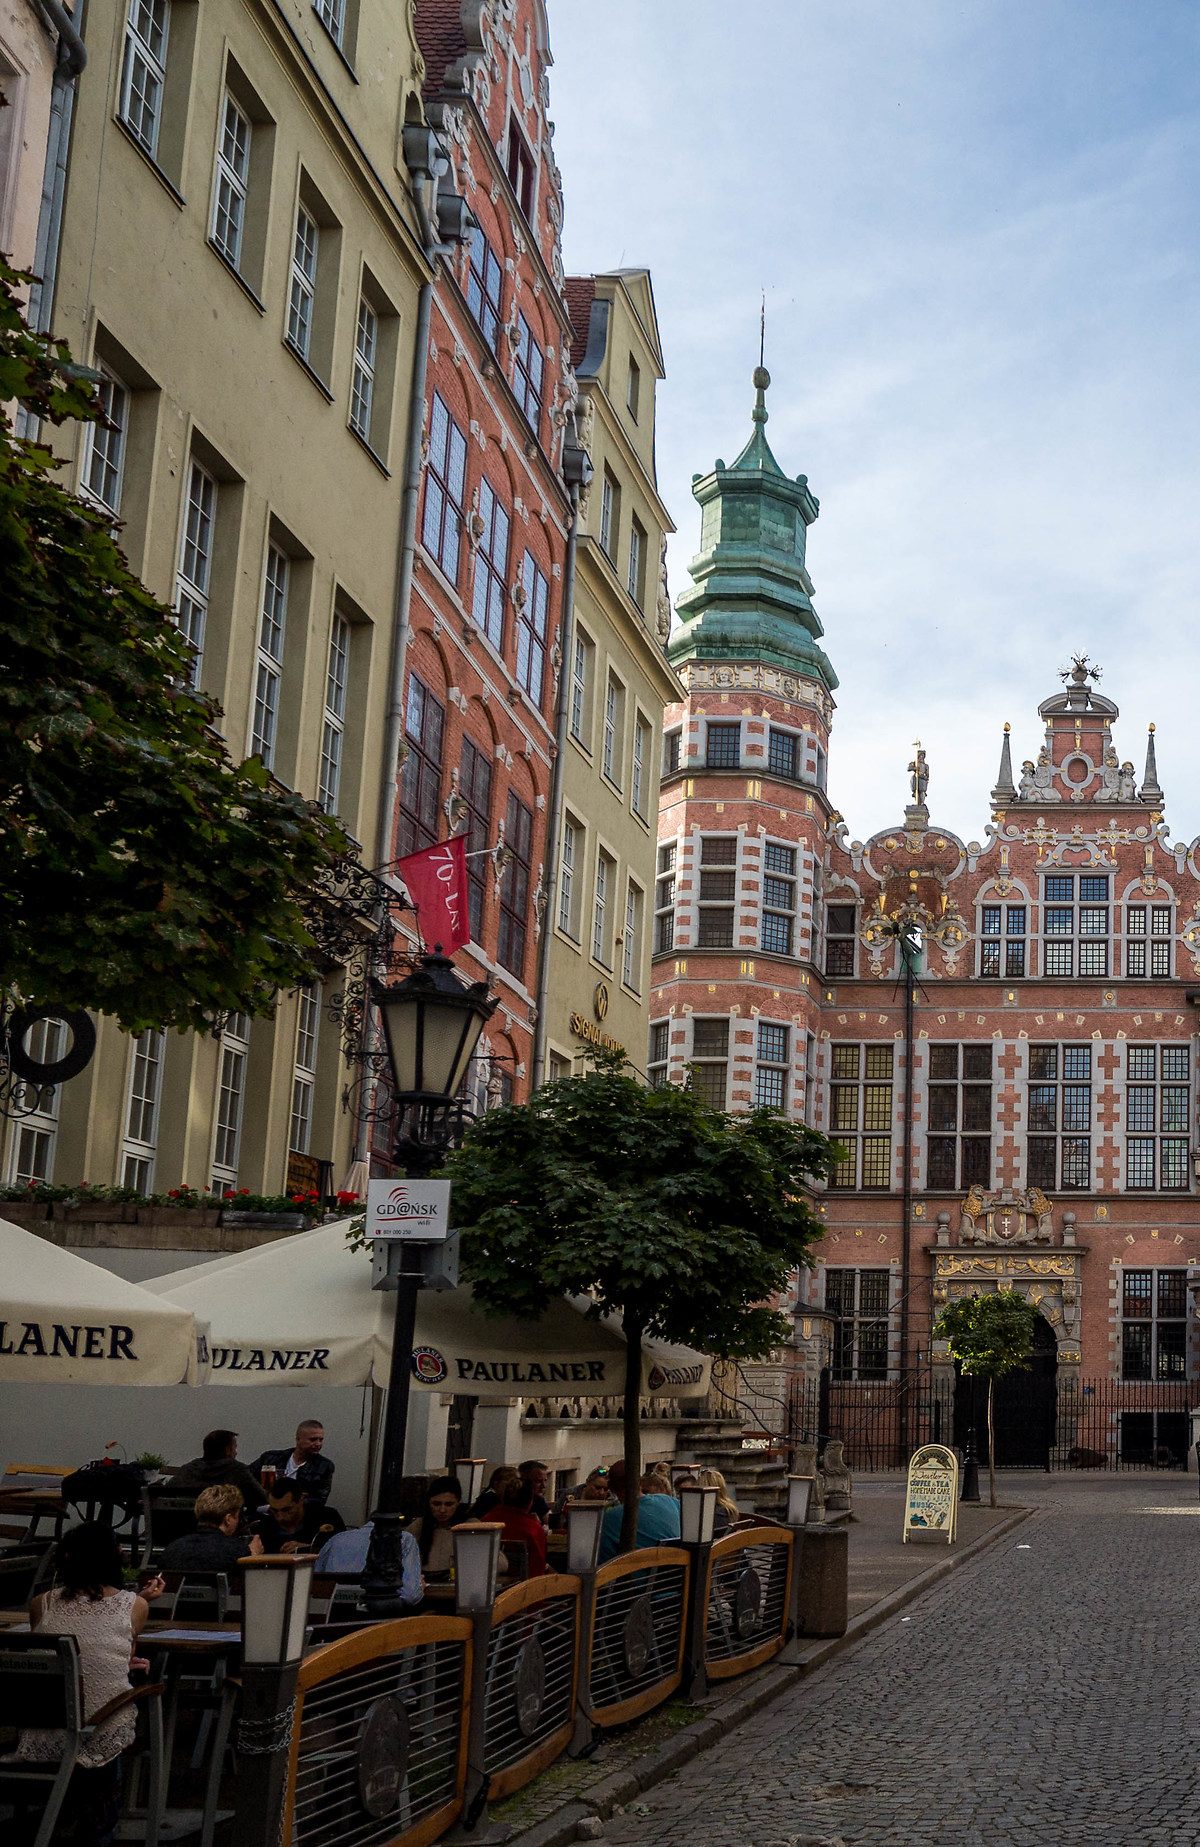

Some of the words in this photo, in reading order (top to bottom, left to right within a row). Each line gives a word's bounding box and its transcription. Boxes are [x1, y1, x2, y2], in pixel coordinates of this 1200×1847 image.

[0, 1321, 139, 1360] LANER
[212, 1348, 330, 1371] ULANER
[455, 1357, 606, 1383] PAULANER
[178, 1589, 205, 1599] eken
[334, 1591, 361, 1601] einek
